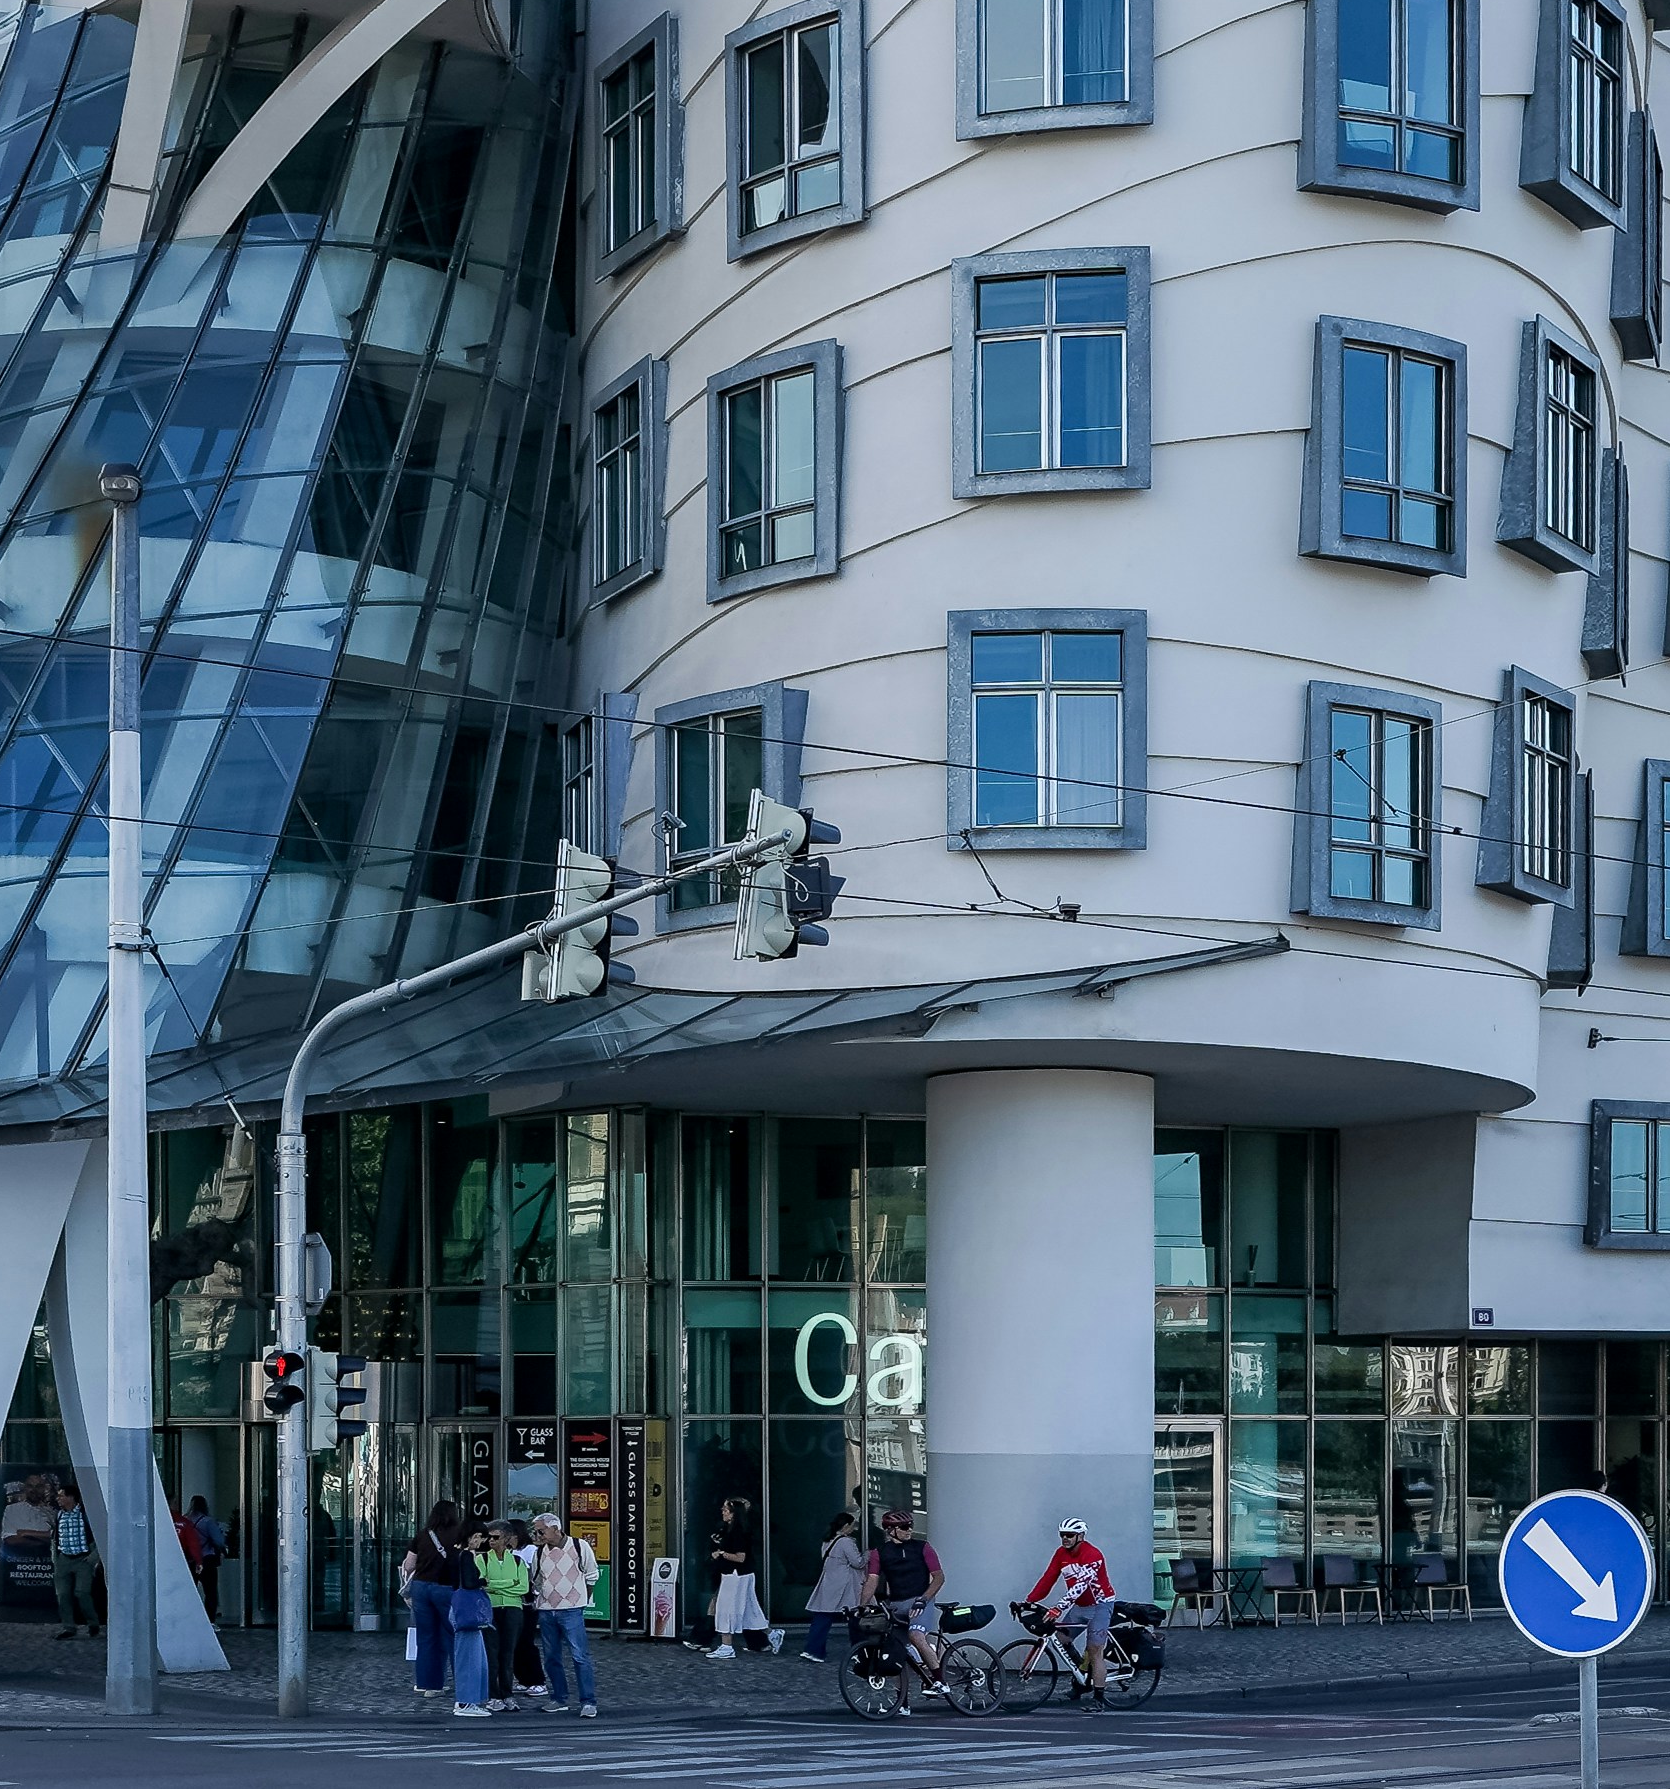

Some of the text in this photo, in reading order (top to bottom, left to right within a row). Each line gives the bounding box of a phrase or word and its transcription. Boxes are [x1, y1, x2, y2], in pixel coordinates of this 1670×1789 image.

[795, 1313, 923, 1406] Ca
[531, 1427, 554, 1437] GLASS
[531, 1437, 546, 1445] BAR
[473, 1440, 490, 1516] GLAS
[628, 1451, 636, 1498] GLASS
[628, 1503, 636, 1532] BAR
[628, 1584, 636, 1614] TOP
